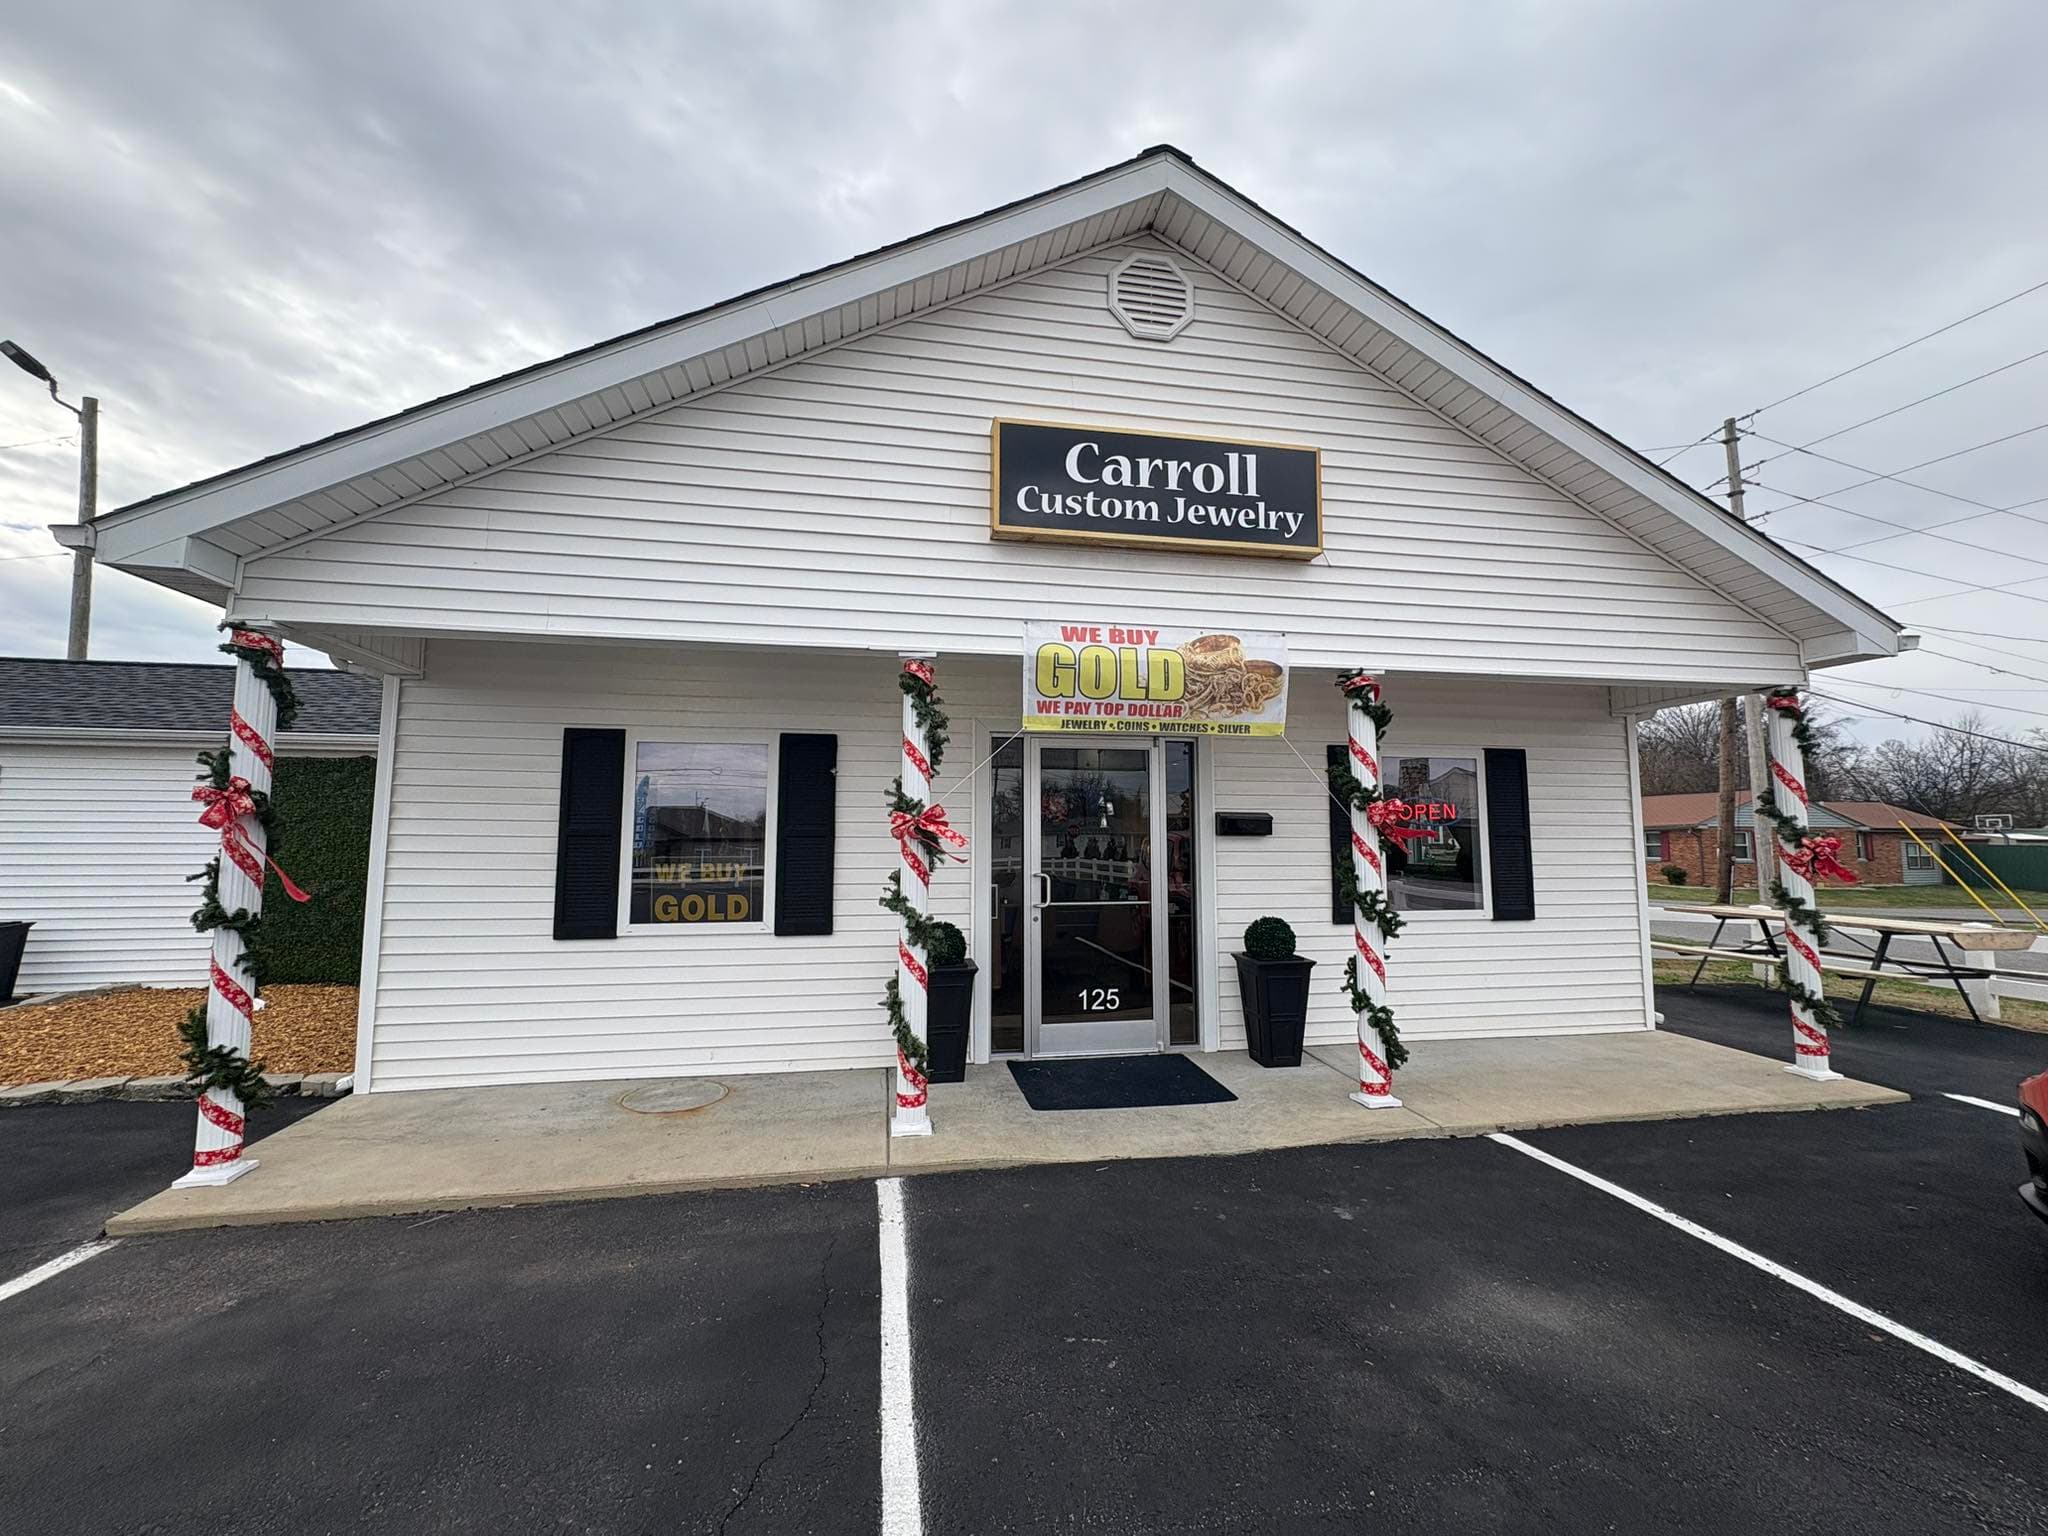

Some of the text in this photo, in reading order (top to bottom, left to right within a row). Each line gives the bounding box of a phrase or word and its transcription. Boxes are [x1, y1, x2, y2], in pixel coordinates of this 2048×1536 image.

[1065, 442, 1261, 497] Carroll
[1017, 485, 1305, 538] Custom Jewelry
[1060, 626, 1159, 646] WE BUY
[1035, 642, 1186, 701] GOLD
[1036, 700, 1184, 718] WE PAY TOP DOLLAR
[1060, 719, 1251, 734] JEWELRY COINS WATCHES SILVER
[1399, 803, 1456, 820] OPEN
[655, 863, 748, 882] WE BUY
[654, 894, 749, 921] GOLD
[1078, 988, 1120, 1010] 125
